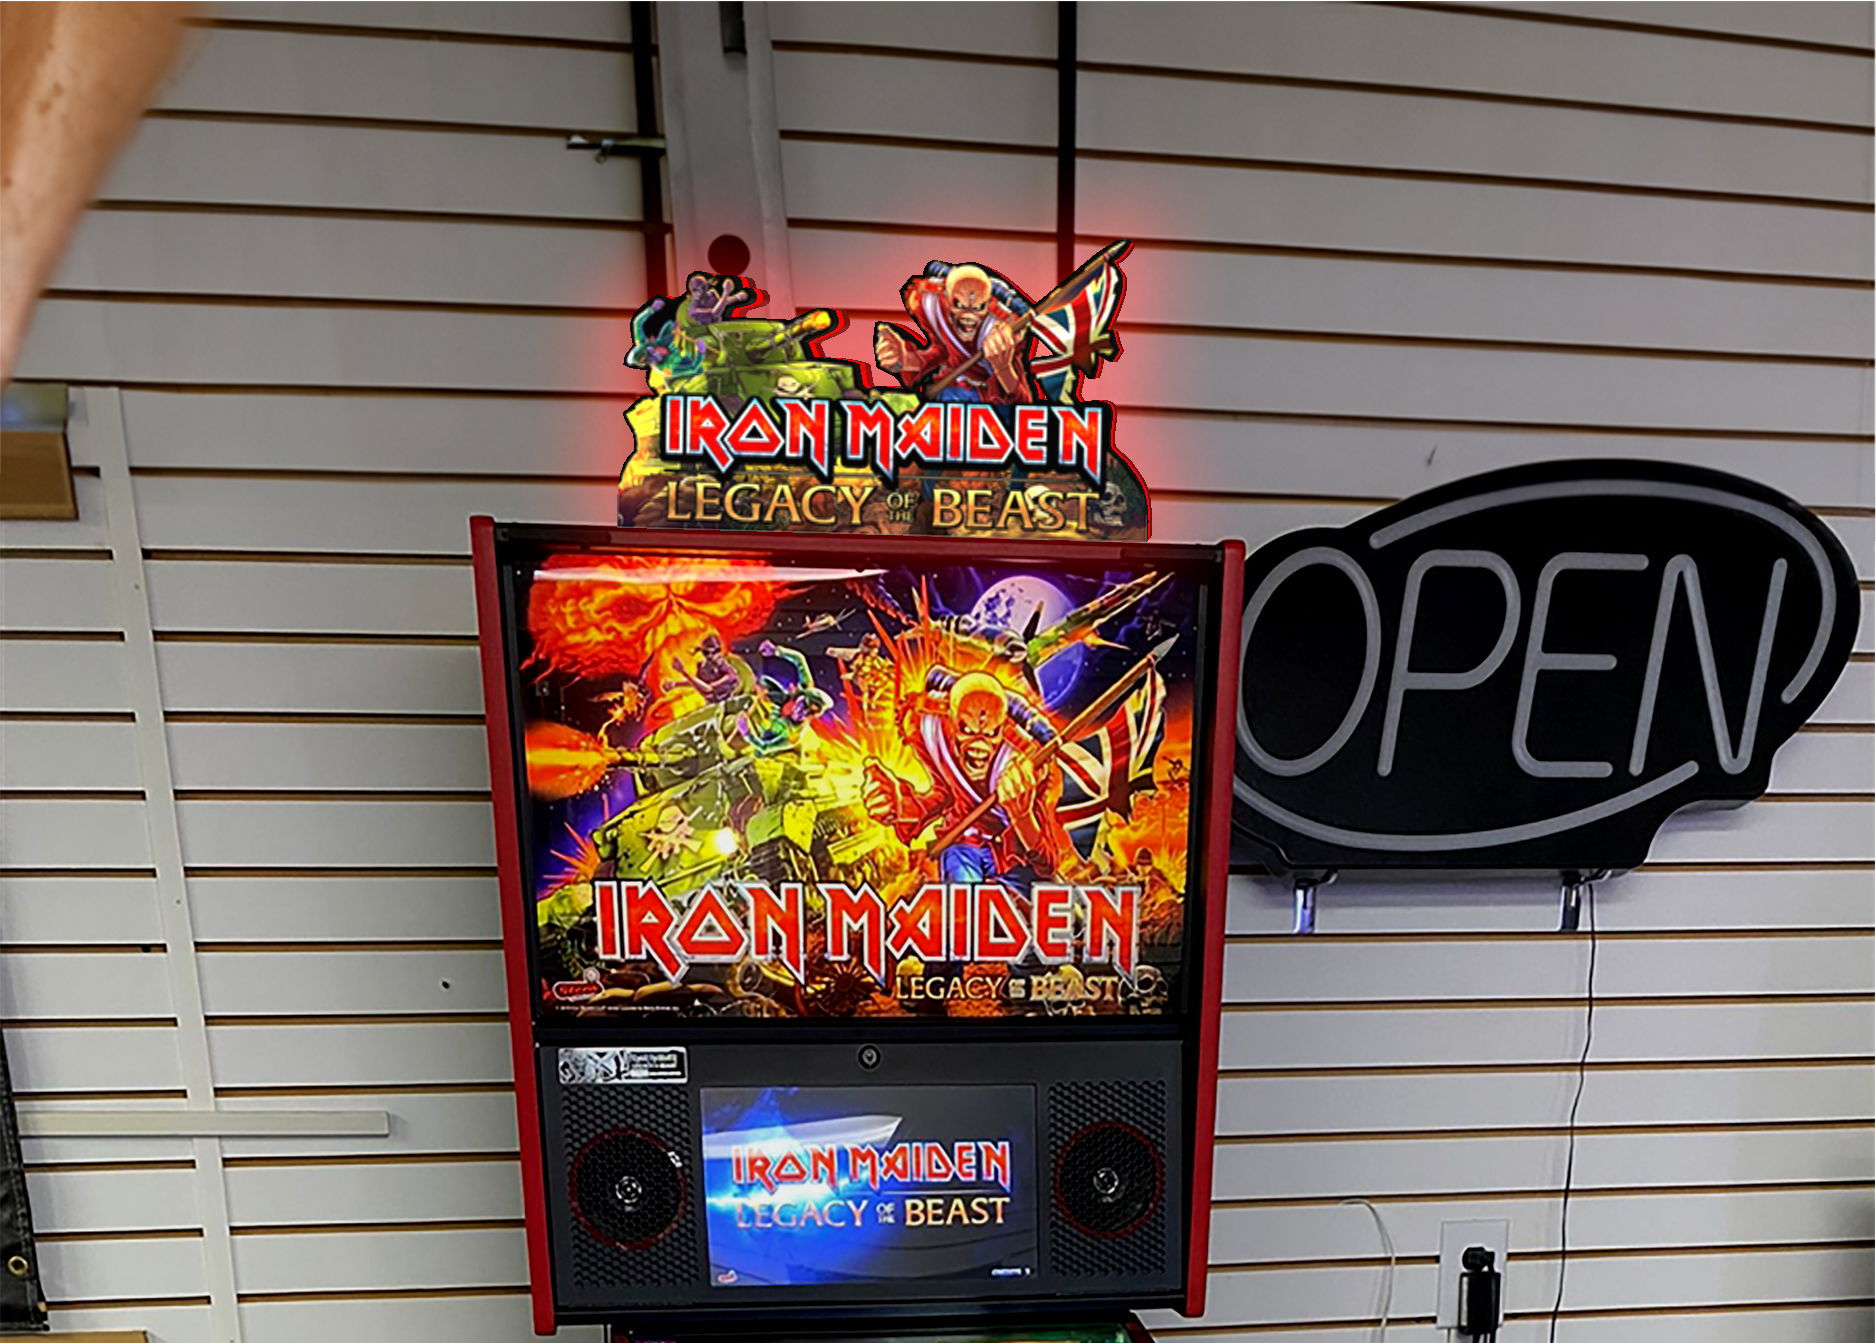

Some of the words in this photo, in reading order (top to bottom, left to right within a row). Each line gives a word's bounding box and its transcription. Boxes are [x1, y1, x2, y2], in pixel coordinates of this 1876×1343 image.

[665, 395, 830, 478] IRON
[841, 399, 1102, 486] MAIDEN
[665, 481, 875, 526] LEGACY
[887, 492, 916, 509] OF
[932, 488, 1100, 532] BEAST
[1236, 545, 1788, 778] OPEN
[594, 880, 806, 986] IRON
[817, 881, 1141, 991] MAIDEN
[896, 976, 1002, 999] LEGACY
[1030, 975, 1118, 1001] BEAST
[732, 1143, 839, 1195] IRON
[849, 1141, 1011, 1193] MAIDEN
[736, 1200, 868, 1229] LEGACY
[905, 1197, 1011, 1227] BEAST
